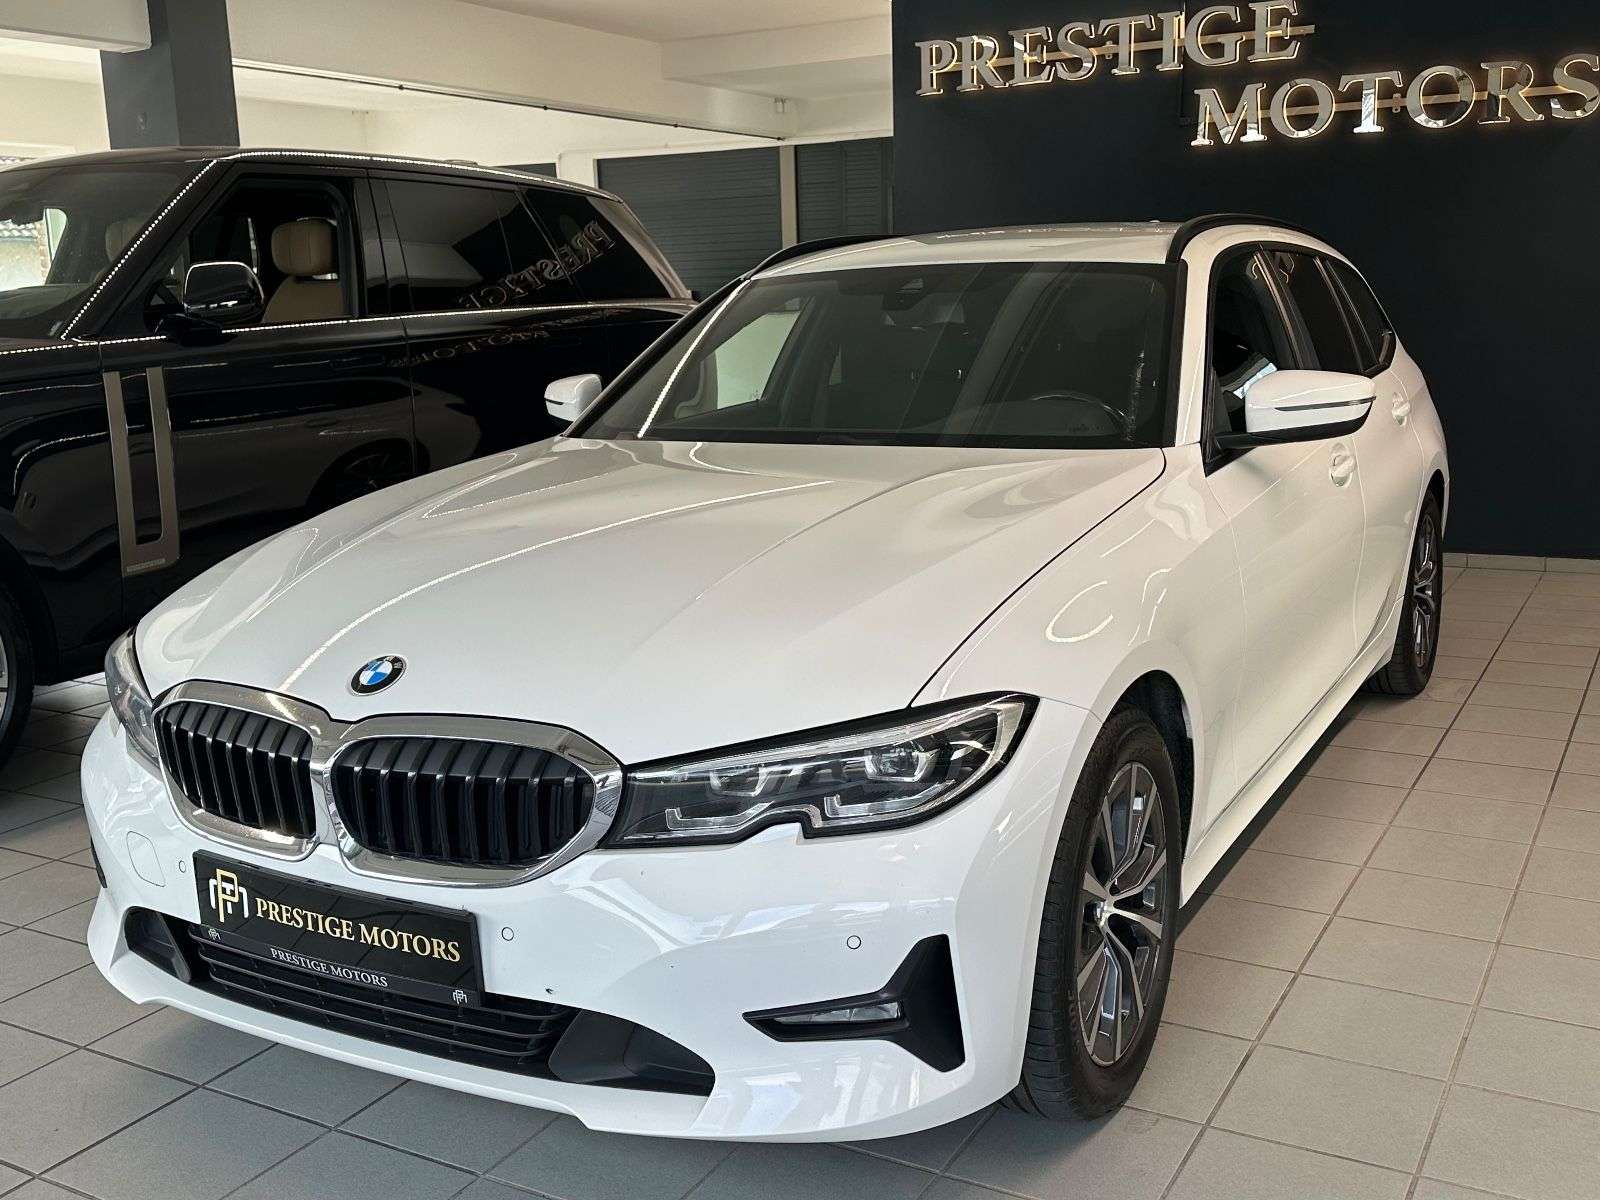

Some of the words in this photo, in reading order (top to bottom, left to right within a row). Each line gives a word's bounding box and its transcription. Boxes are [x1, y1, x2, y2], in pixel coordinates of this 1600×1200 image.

[915, 0, 1300, 96] PRESTIGE
[1190, 53, 1600, 147] MOTORS
[255, 897, 355, 941] PRESTIGE
[359, 923, 461, 962] MOTORS
[270, 947, 329, 974] PRESTIGE
[330, 965, 388, 987] MOTORS
